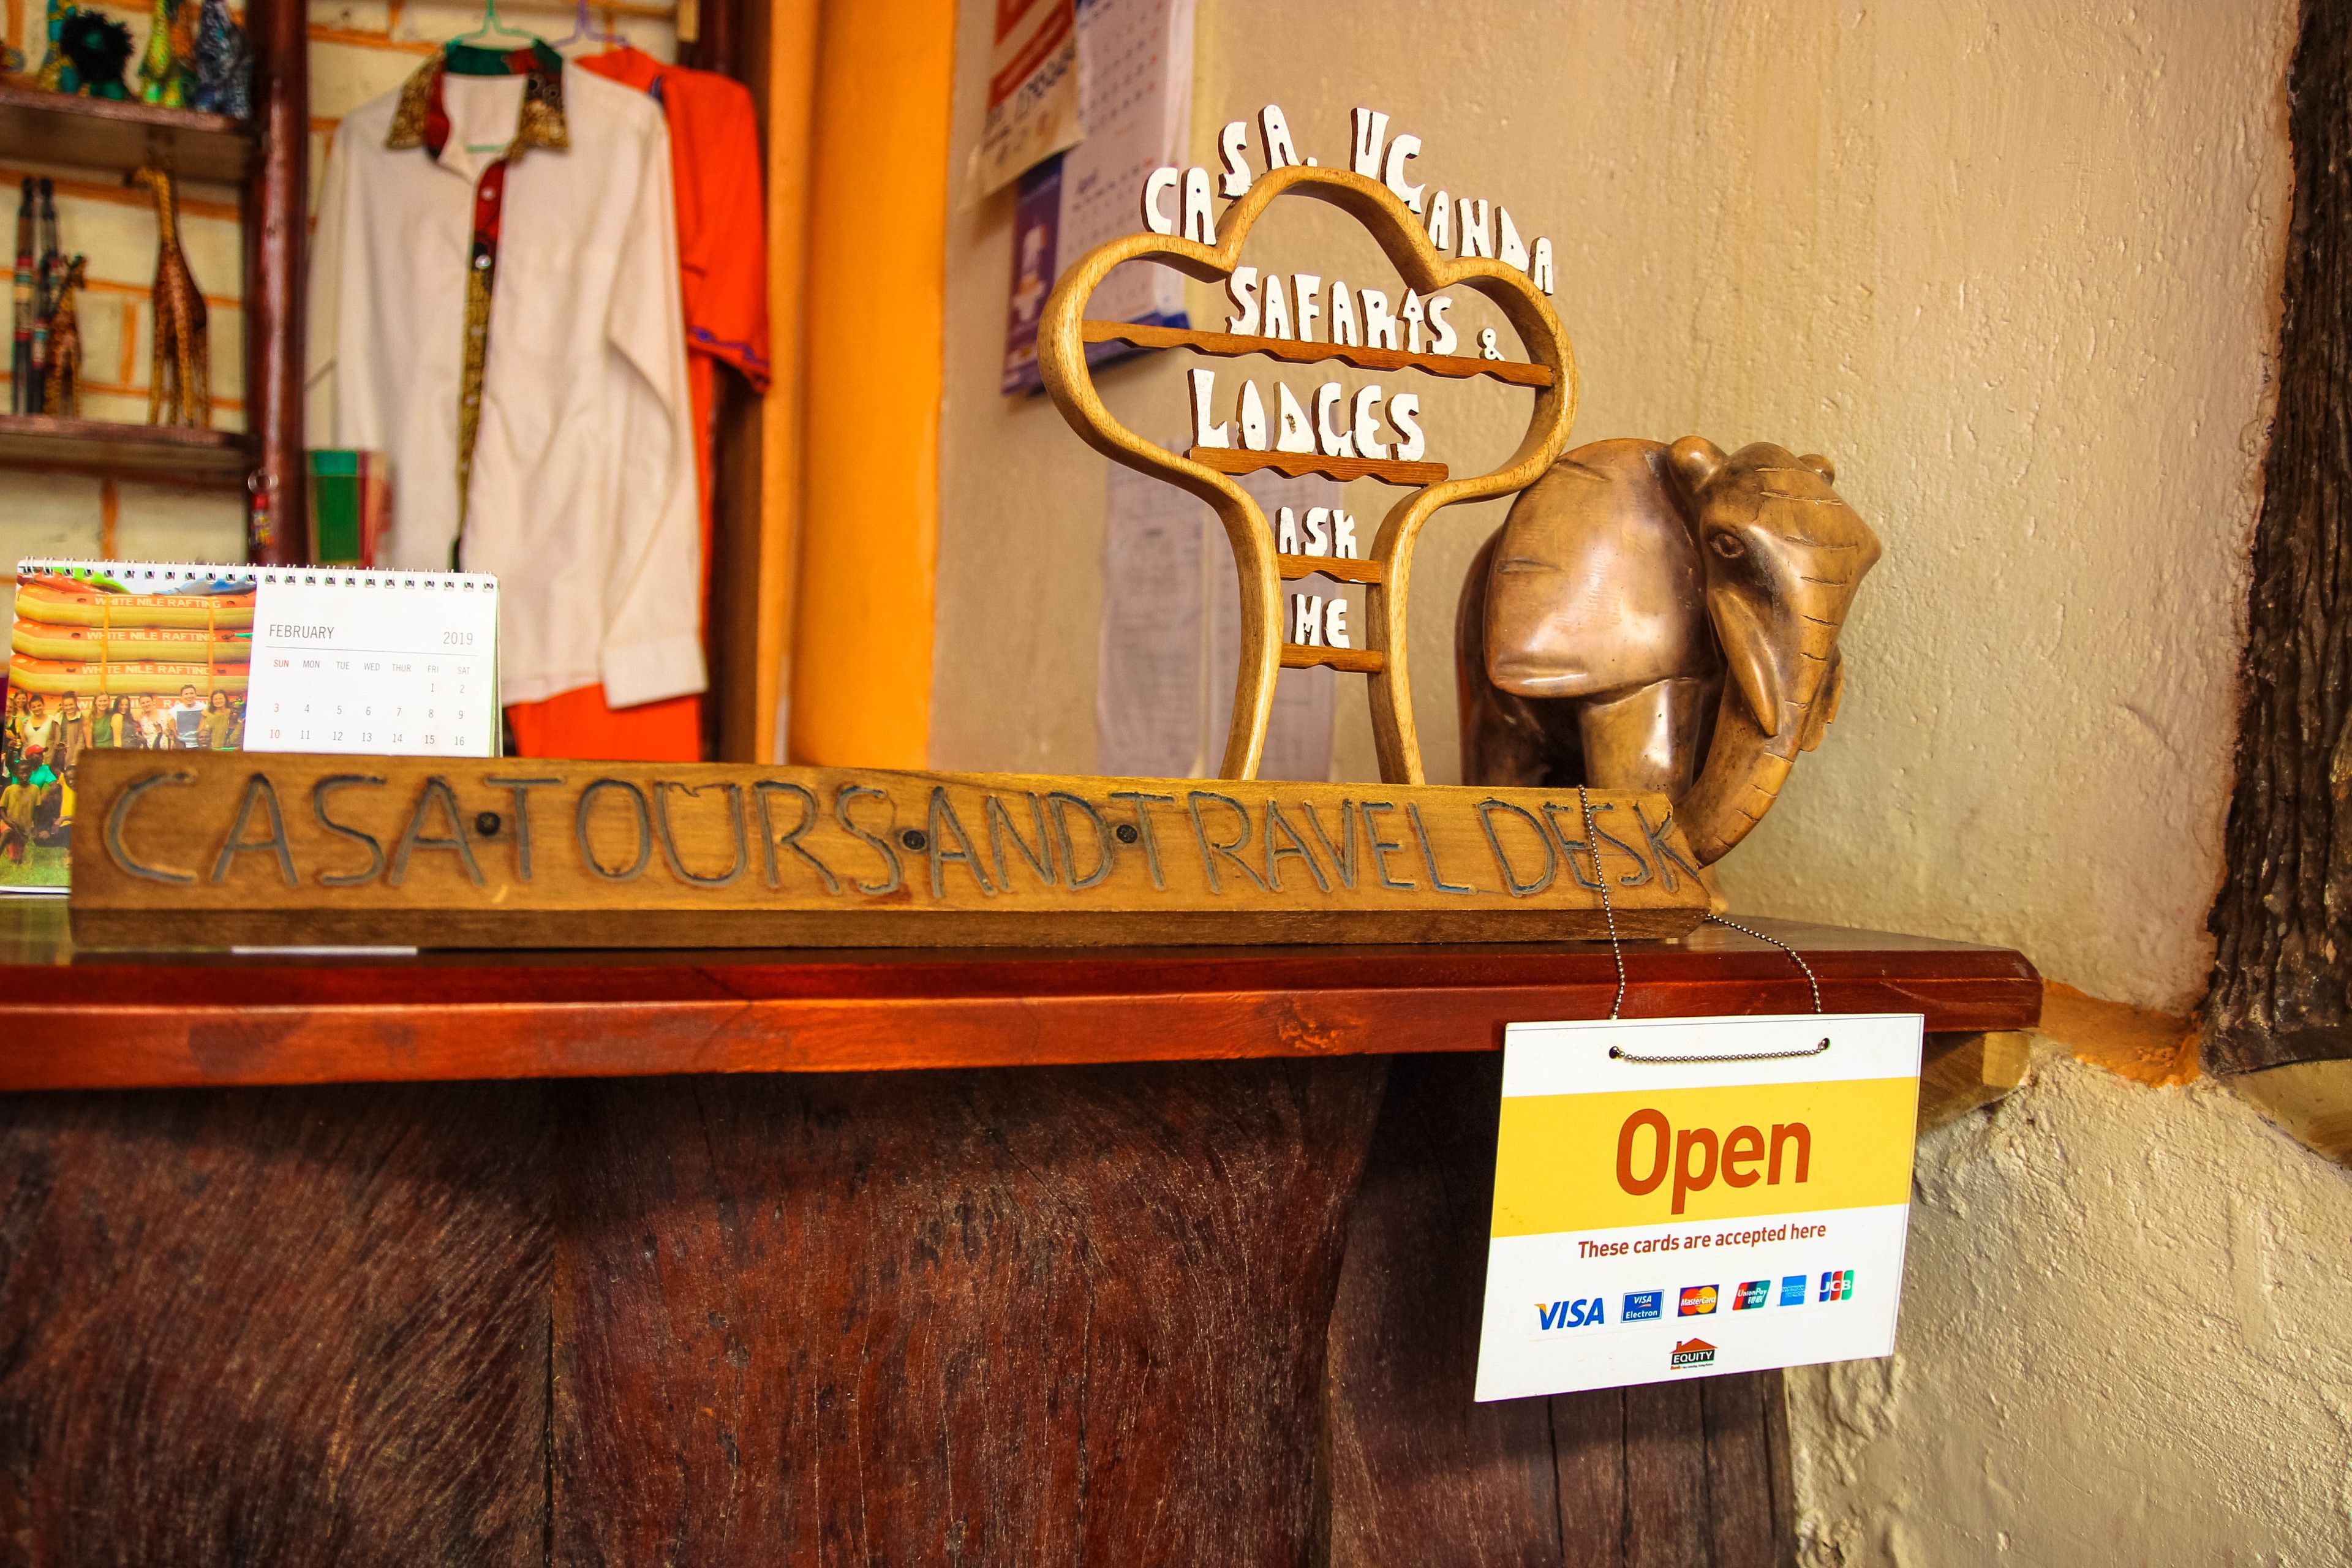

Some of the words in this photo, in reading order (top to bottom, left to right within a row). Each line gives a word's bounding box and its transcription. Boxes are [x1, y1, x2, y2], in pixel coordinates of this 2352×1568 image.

[1351, 107, 1554, 296] UGANDA
[1226, 267, 1457, 356] SAFARIS
[1480, 328, 1505, 361] &
[1188, 369, 1425, 462] LODGES
[1275, 507, 1357, 559] ASK
[137, 598, 164, 607] NILE
[167, 598, 221, 608] RAFTING
[1291, 594, 1350, 649] ME
[130, 632, 158, 641] NILE
[269, 624, 335, 639] FEBRUARY
[443, 631, 474, 646] 2019
[81, 665, 120, 674] WHTE
[125, 666, 153, 674] NILE
[273, 659, 290, 668] SUN
[303, 660, 320, 669] MON
[336, 661, 350, 670] TUE
[364, 662, 380, 671] WED
[392, 663, 412, 673] THUR
[428, 665, 439, 674] FRI
[457, 666, 471, 675] SAT
[430, 683, 435, 693] 1
[459, 684, 465, 693] 2
[274, 703, 279, 712] 3
[304, 704, 310, 714] 4
[336, 706, 342, 715] 5
[366, 706, 371, 716] 6
[396, 708, 402, 717] 7
[428, 709, 434, 718] 8
[458, 710, 464, 720] 9
[270, 729, 281, 739] 10
[301, 730, 311, 740] 11
[333, 731, 343, 741] 12
[362, 733, 372, 742] 13
[393, 734, 402, 743] 14
[424, 735, 435, 744] 15
[454, 737, 465, 746] 16
[104, 771, 486, 888] CASA
[484, 777, 903, 895] TOURS
[927, 785, 1114, 897] AND
[1107, 790, 1477, 893] TRAVEL
[1477, 797, 1702, 897] DESK
[1616, 1108, 1811, 1215] Open
[1578, 1240, 1629, 1259] These
[1633, 1234, 1679, 1254] cards
[1683, 1234, 1711, 1249] are
[1715, 1224, 1787, 1248] accepted
[1790, 1223, 1826, 1240] here
[1737, 1287, 1767, 1298] UnionPay
[1820, 1280, 1852, 1292] JCB
[1634, 1295, 1653, 1304] VISA
[1680, 1296, 1716, 1306] MasterCard
[1534, 1297, 1605, 1330] VISA
[1626, 1310, 1658, 1319] Electron
[1673, 1351, 1713, 1363] EQUITY
